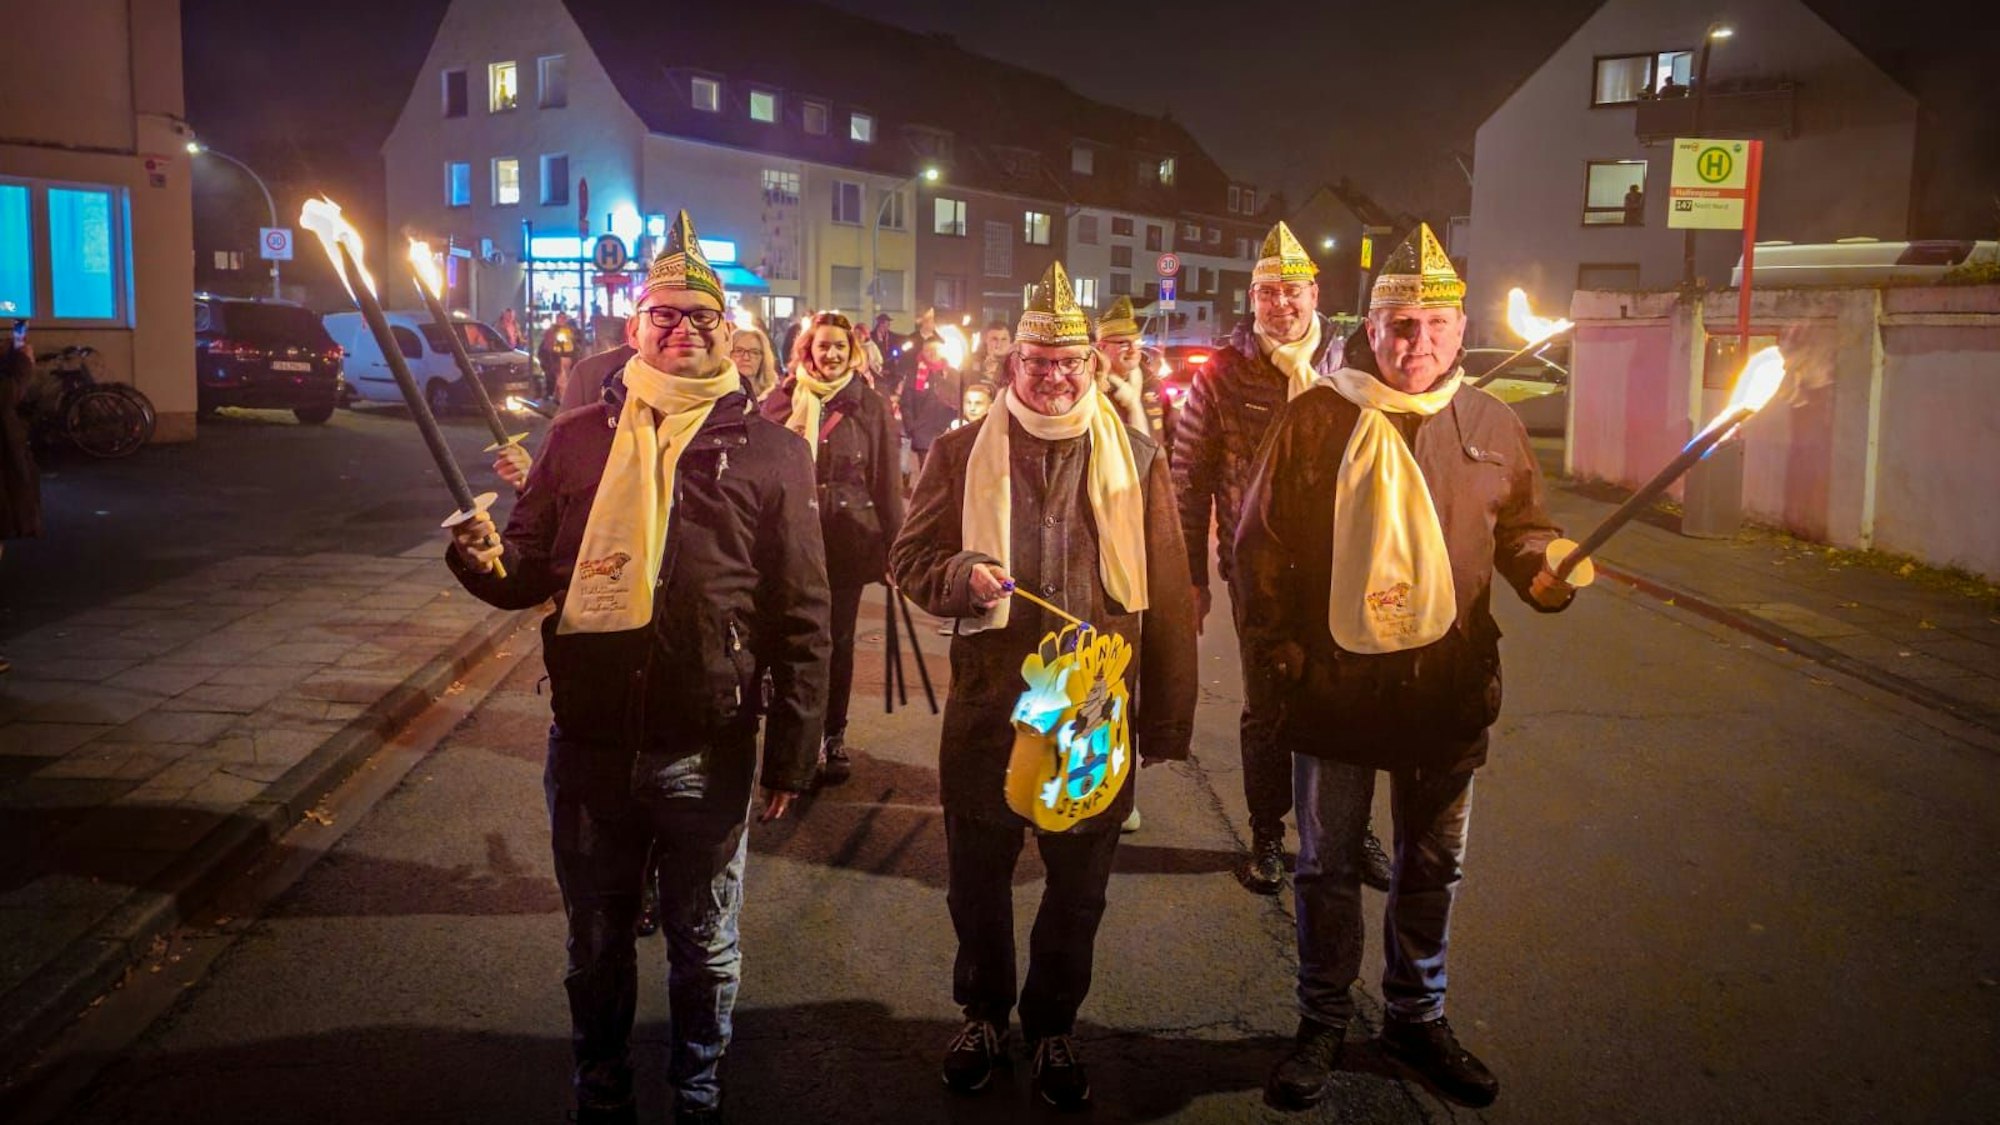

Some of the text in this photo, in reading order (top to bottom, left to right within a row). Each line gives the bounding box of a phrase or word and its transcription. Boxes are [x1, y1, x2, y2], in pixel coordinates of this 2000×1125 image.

[1705, 154, 1723, 177] H
[1676, 200, 1692, 211] 147
[599, 243, 618, 265] H
[1162, 260, 1175, 270] 30
